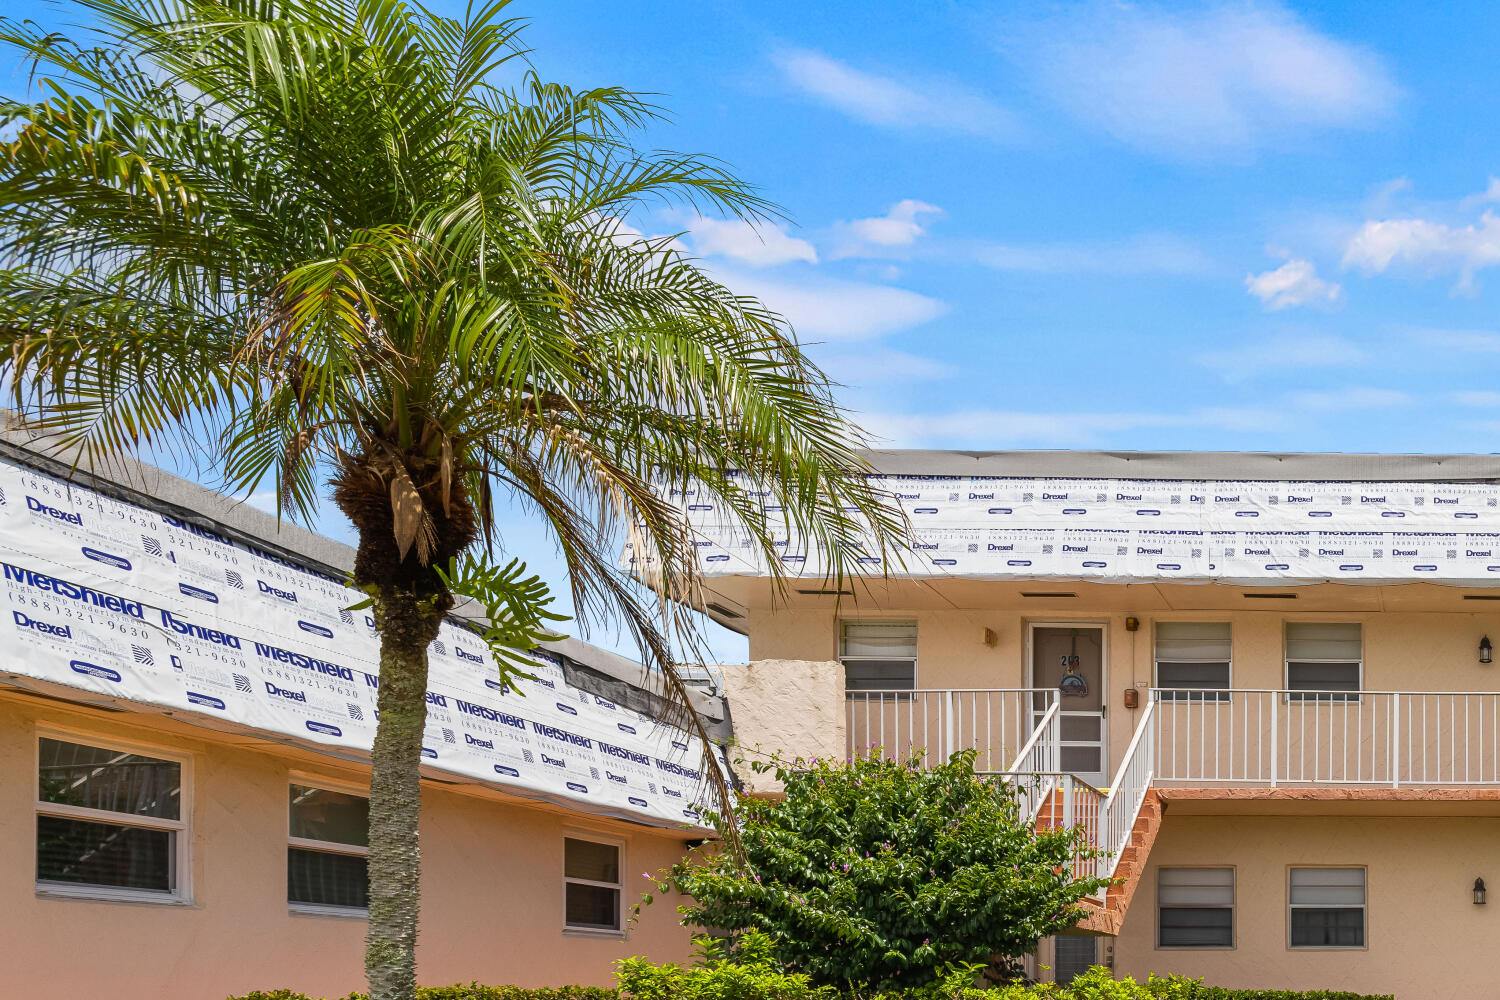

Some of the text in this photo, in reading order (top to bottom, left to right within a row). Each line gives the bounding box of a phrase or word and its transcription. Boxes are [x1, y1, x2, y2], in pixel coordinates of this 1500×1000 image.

[968, 492, 994, 500] Drexel
[26, 496, 84, 526] Drexel
[1062, 544, 1088, 552] Drexel
[1244, 548, 1270, 556] Drexel
[1318, 548, 1344, 556] Drexel
[2, 563, 145, 620] MetShield
[257, 580, 298, 603] Drexel
[9, 591, 150, 640] (888)321-9630
[13, 610, 73, 640] Drexel
[254, 642, 354, 682] MetShield
[456, 646, 484, 664] Drexel
[265, 682, 307, 703] Drexel
[456, 700, 526, 731] MetShield
[464, 734, 494, 750] Drexel
[540, 754, 566, 768] Drexel
